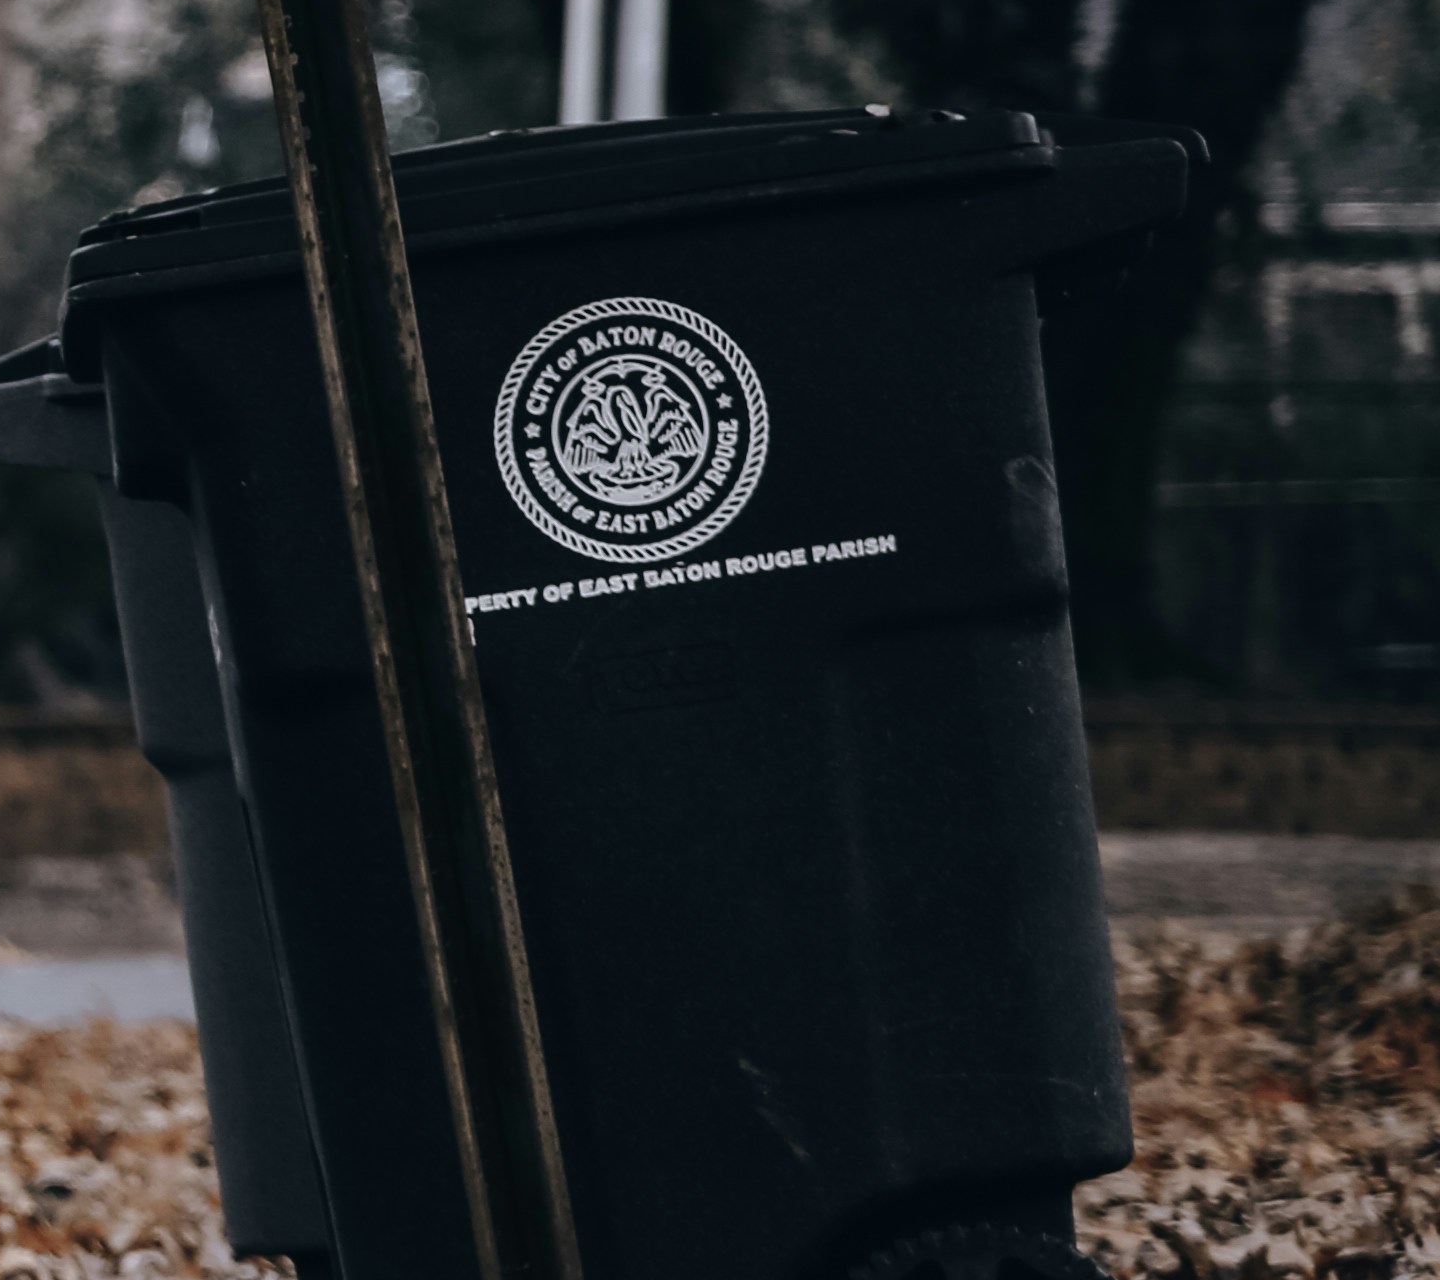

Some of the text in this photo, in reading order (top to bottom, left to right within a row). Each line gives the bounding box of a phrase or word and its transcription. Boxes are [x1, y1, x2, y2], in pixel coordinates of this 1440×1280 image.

[526, 363, 561, 416] CITY
[577, 325, 657, 357] BATON
[657, 331, 726, 390] ROUGE
[525, 446, 579, 513] PARISH
[594, 510, 651, 534] EAST
[651, 480, 716, 531] BATON
[703, 418, 739, 487] ROUGE
[464, 534, 897, 614] PERTY OF EAST BATON ROUGE PARISH
